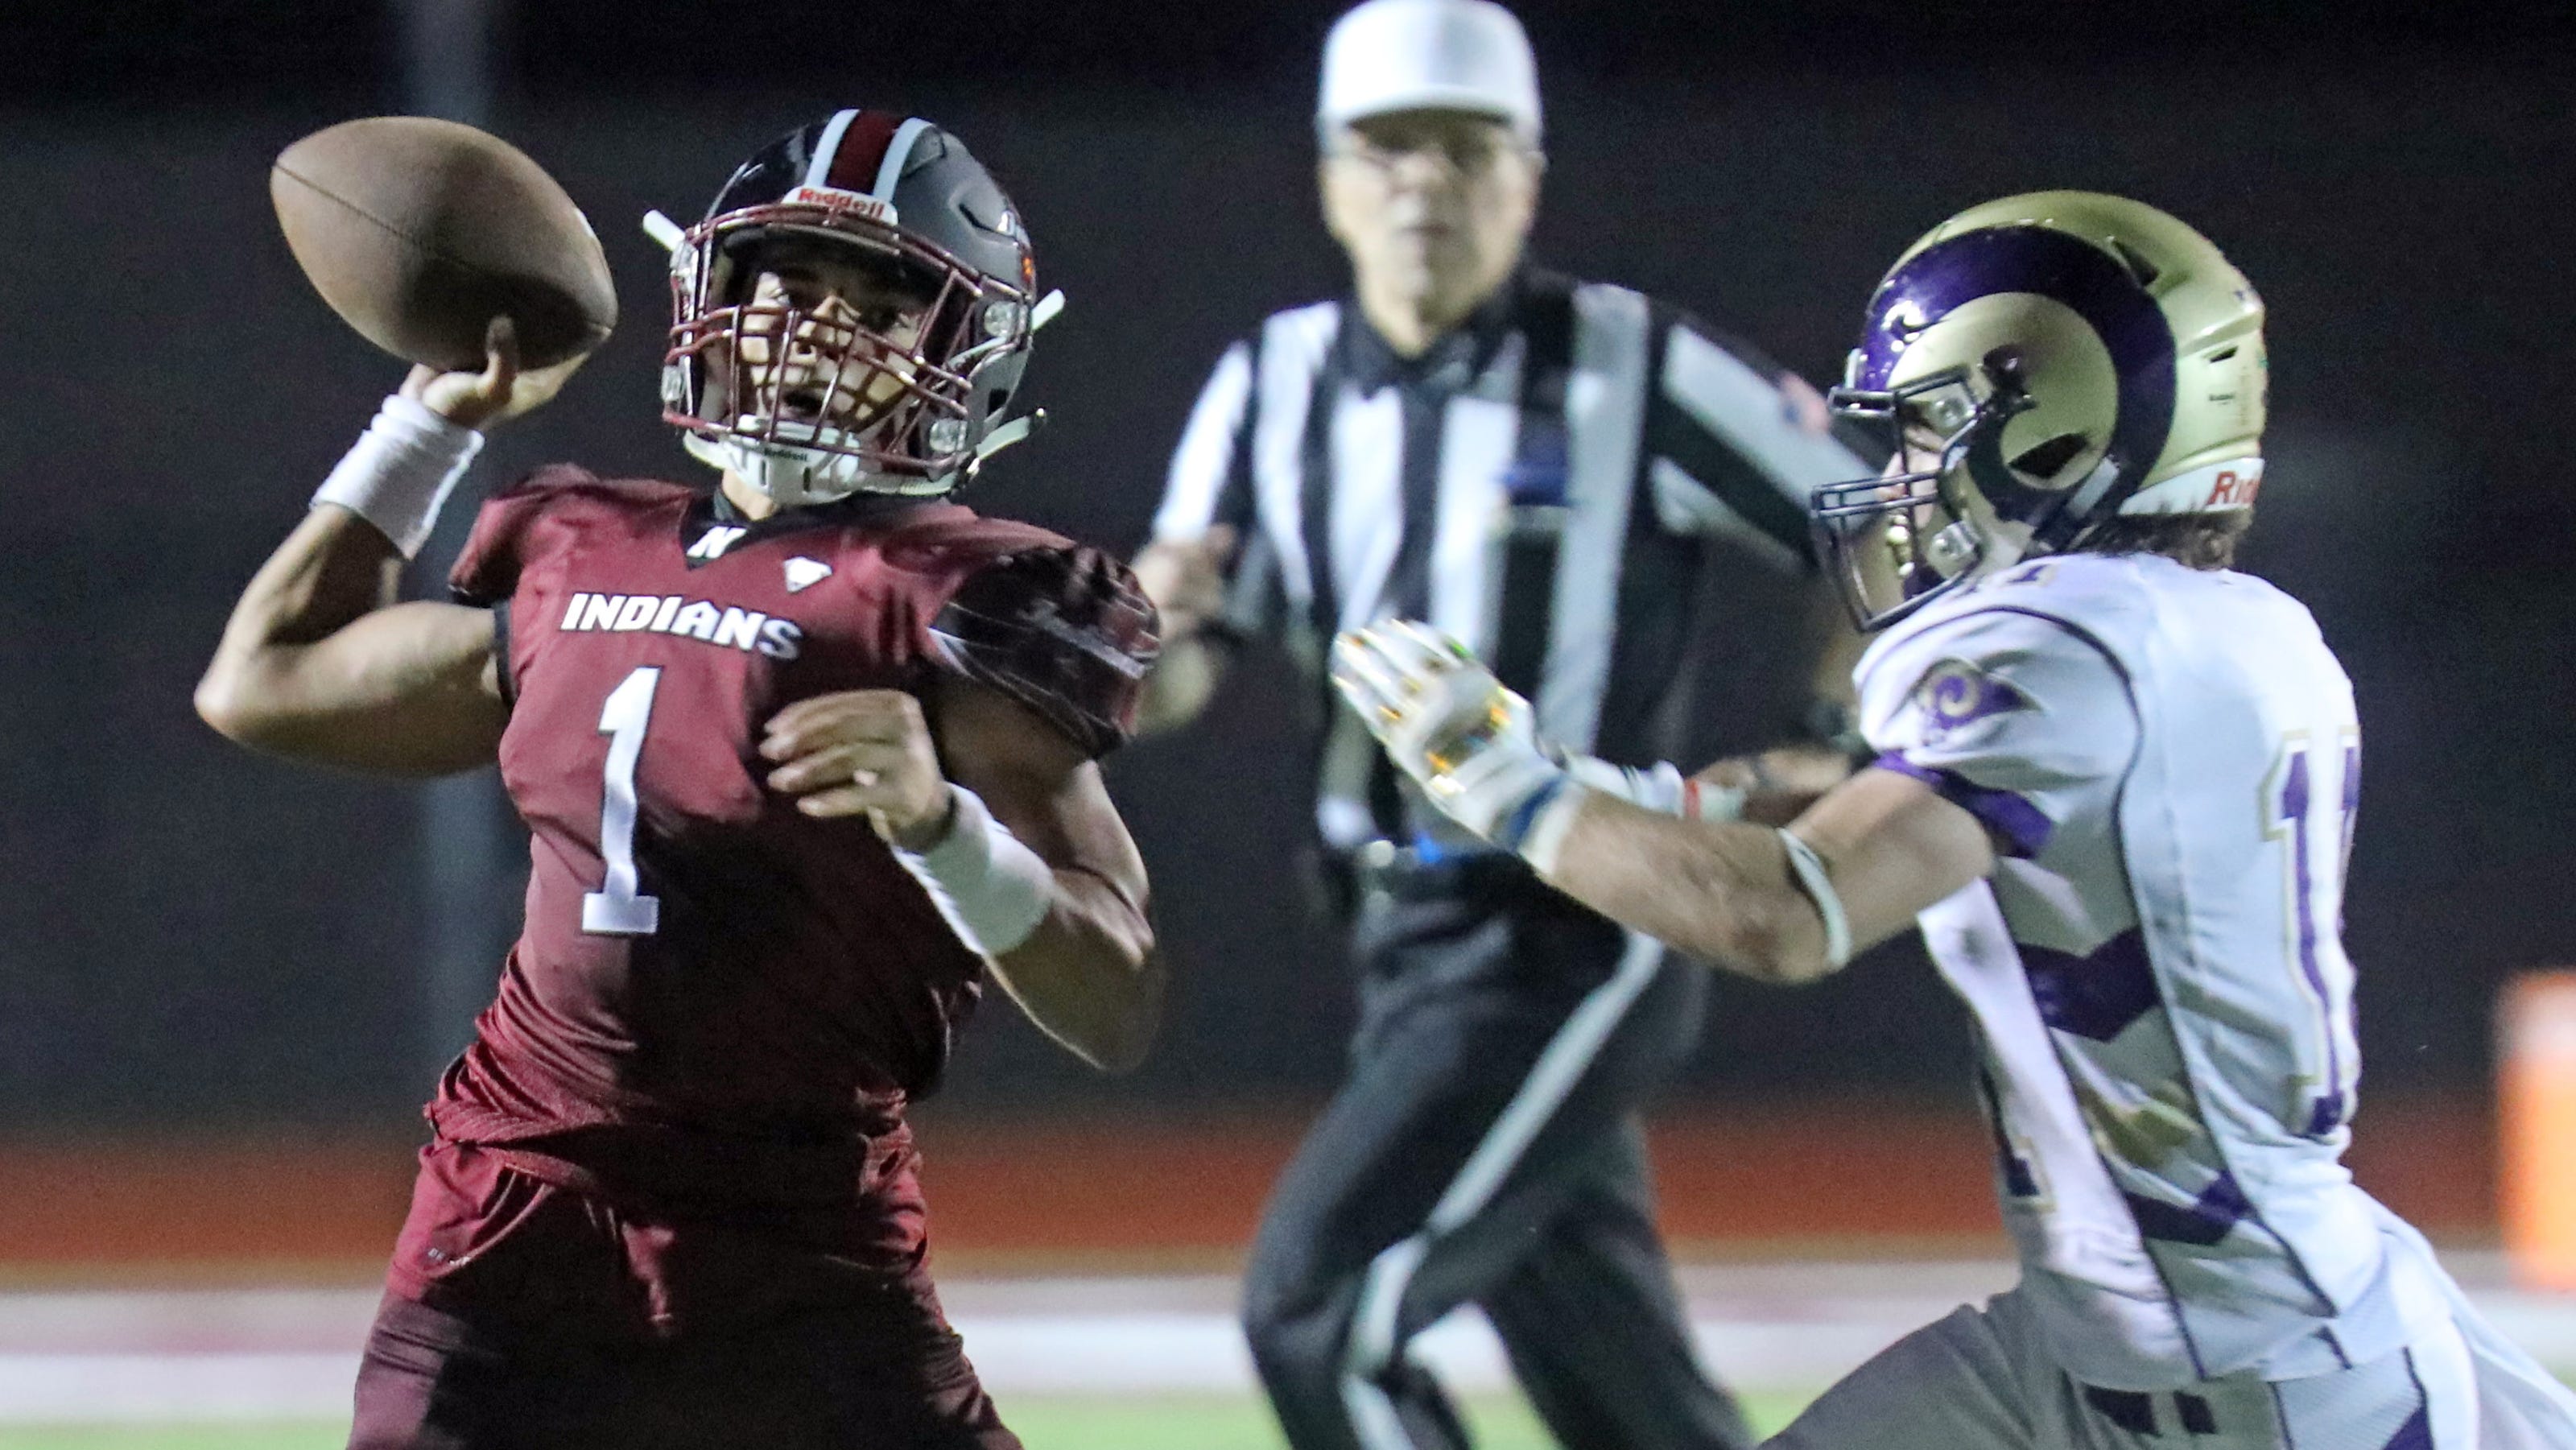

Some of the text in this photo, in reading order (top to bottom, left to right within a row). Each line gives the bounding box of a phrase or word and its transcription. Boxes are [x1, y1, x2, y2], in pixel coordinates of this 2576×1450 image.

[798, 188, 885, 217] Riddell
[686, 525, 748, 560] N
[559, 592, 803, 660] INDIANS
[581, 666, 663, 934] 1
